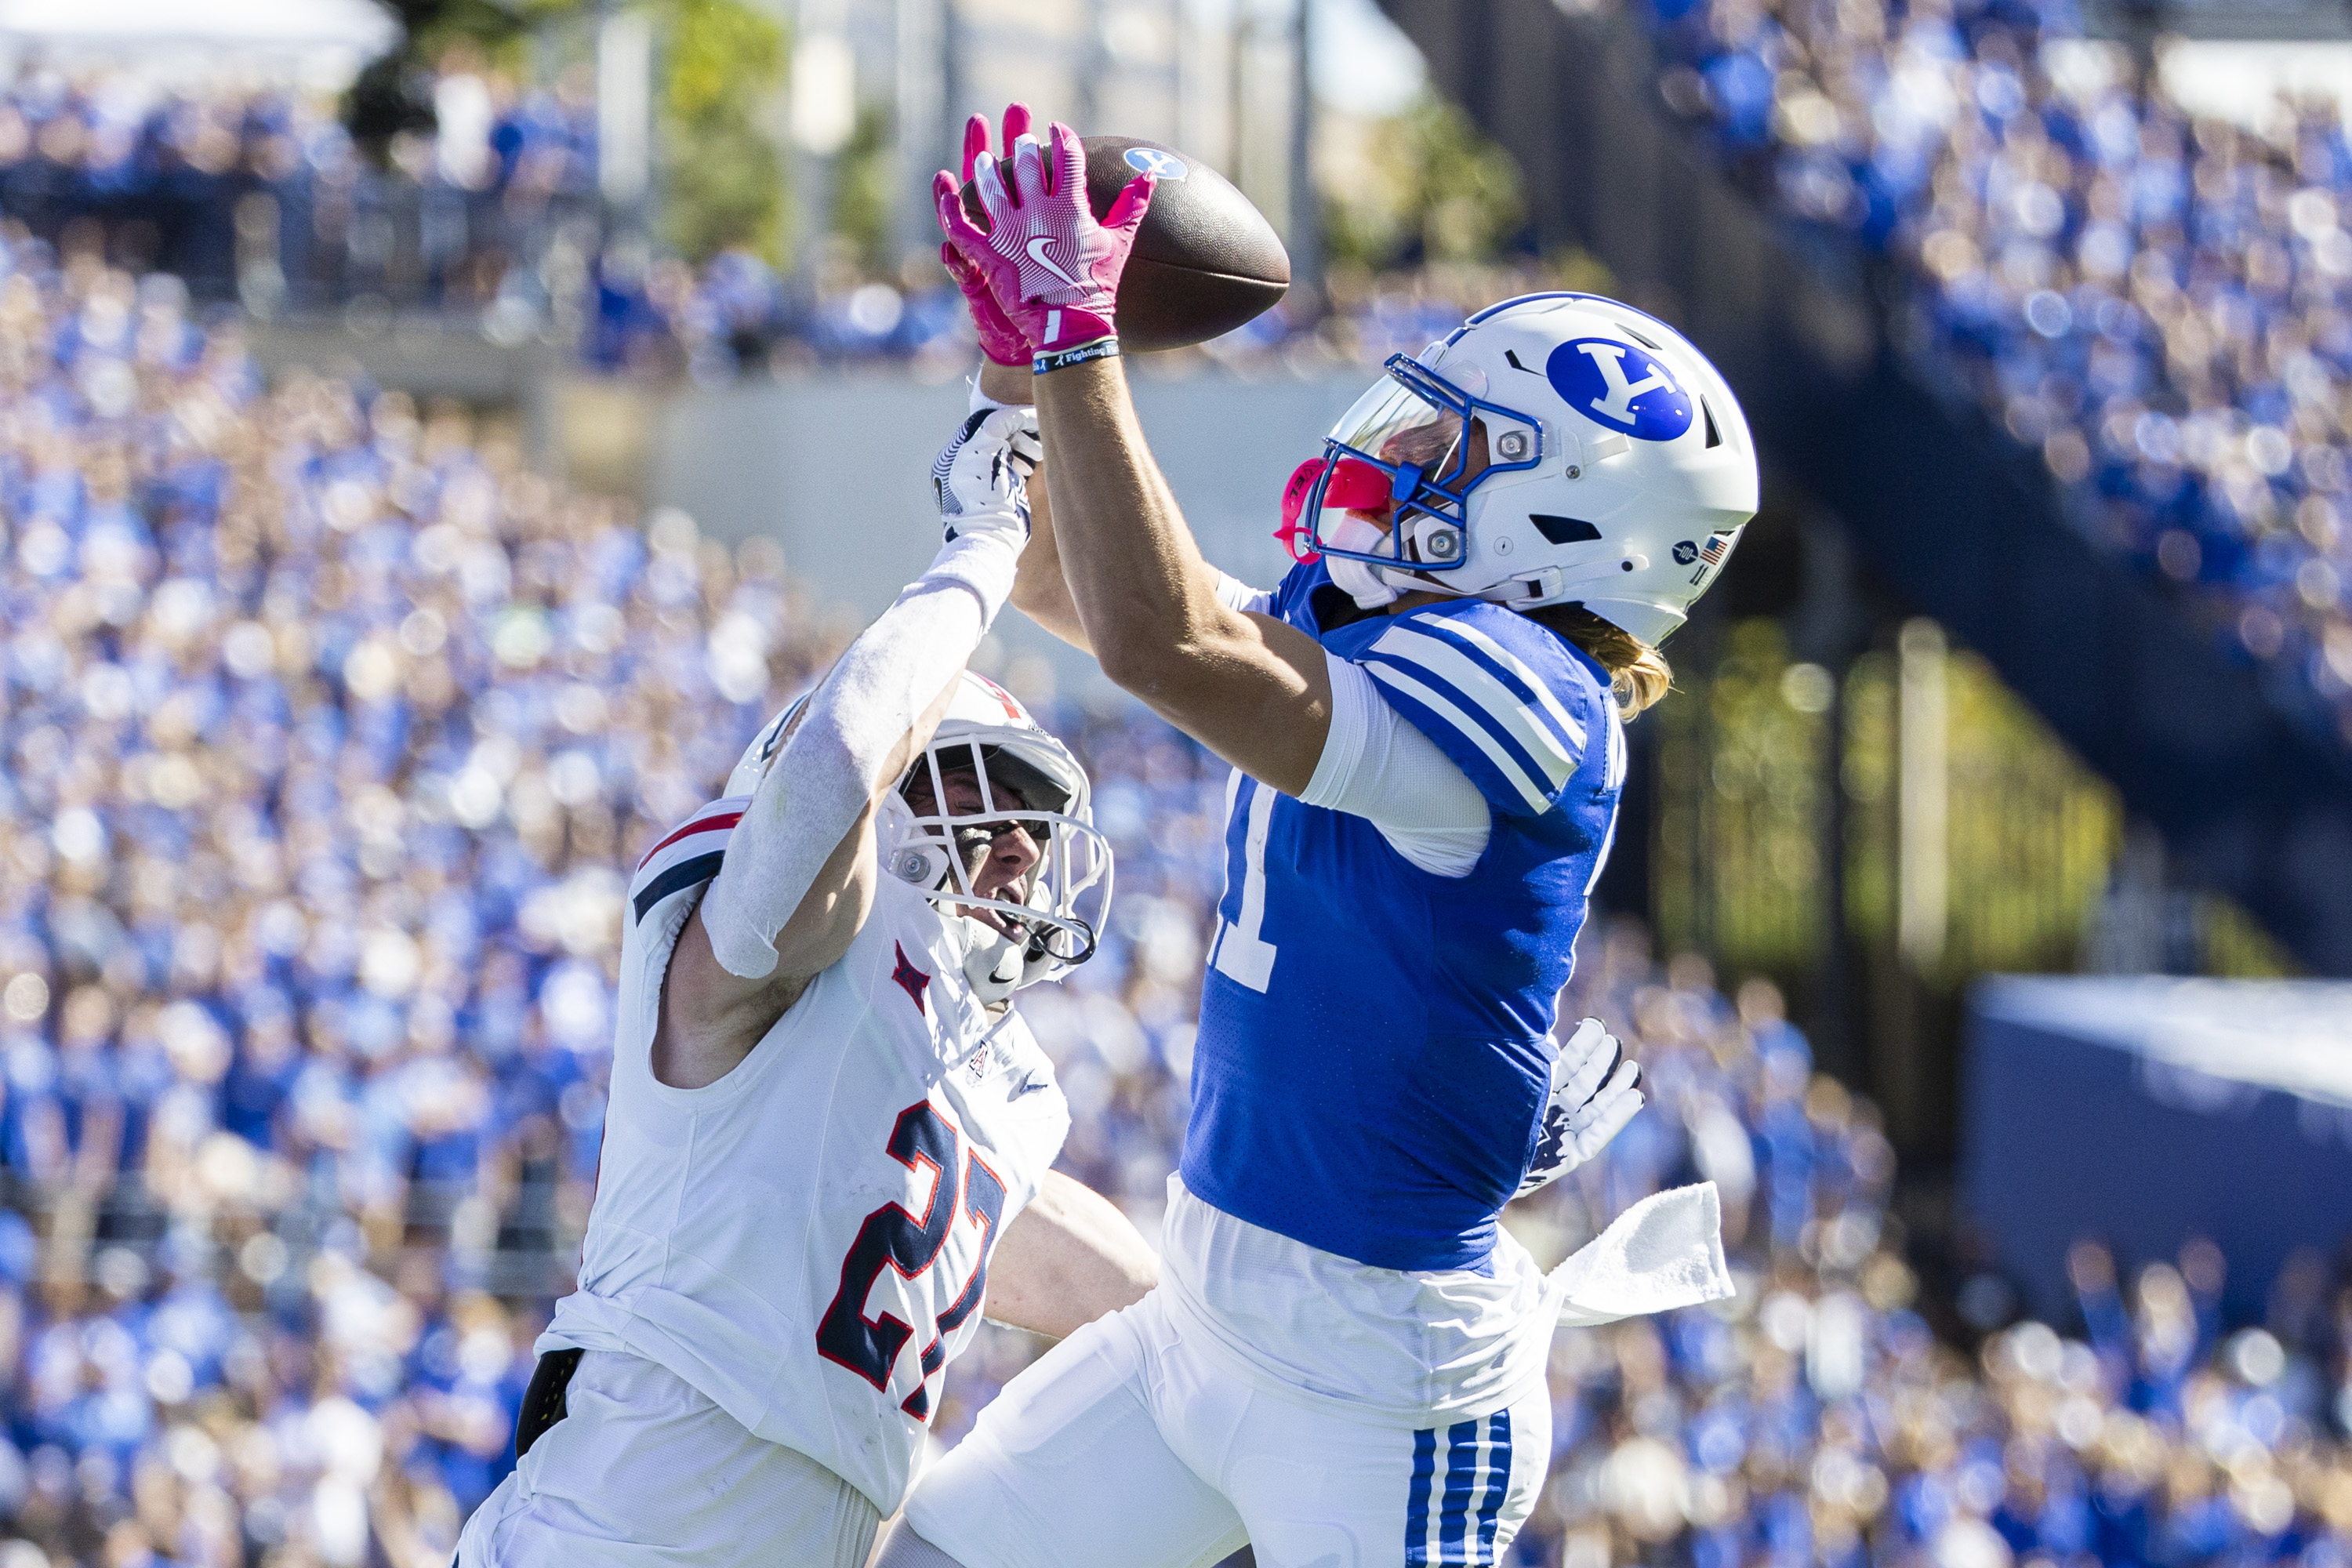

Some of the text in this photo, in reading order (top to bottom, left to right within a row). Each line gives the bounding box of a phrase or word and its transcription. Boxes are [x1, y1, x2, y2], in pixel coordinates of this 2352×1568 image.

[1065, 347, 1105, 362] Fighting
[1577, 343, 1677, 426] Y
[969, 1040, 989, 1078] A
[815, 1099, 1007, 1422] 27
